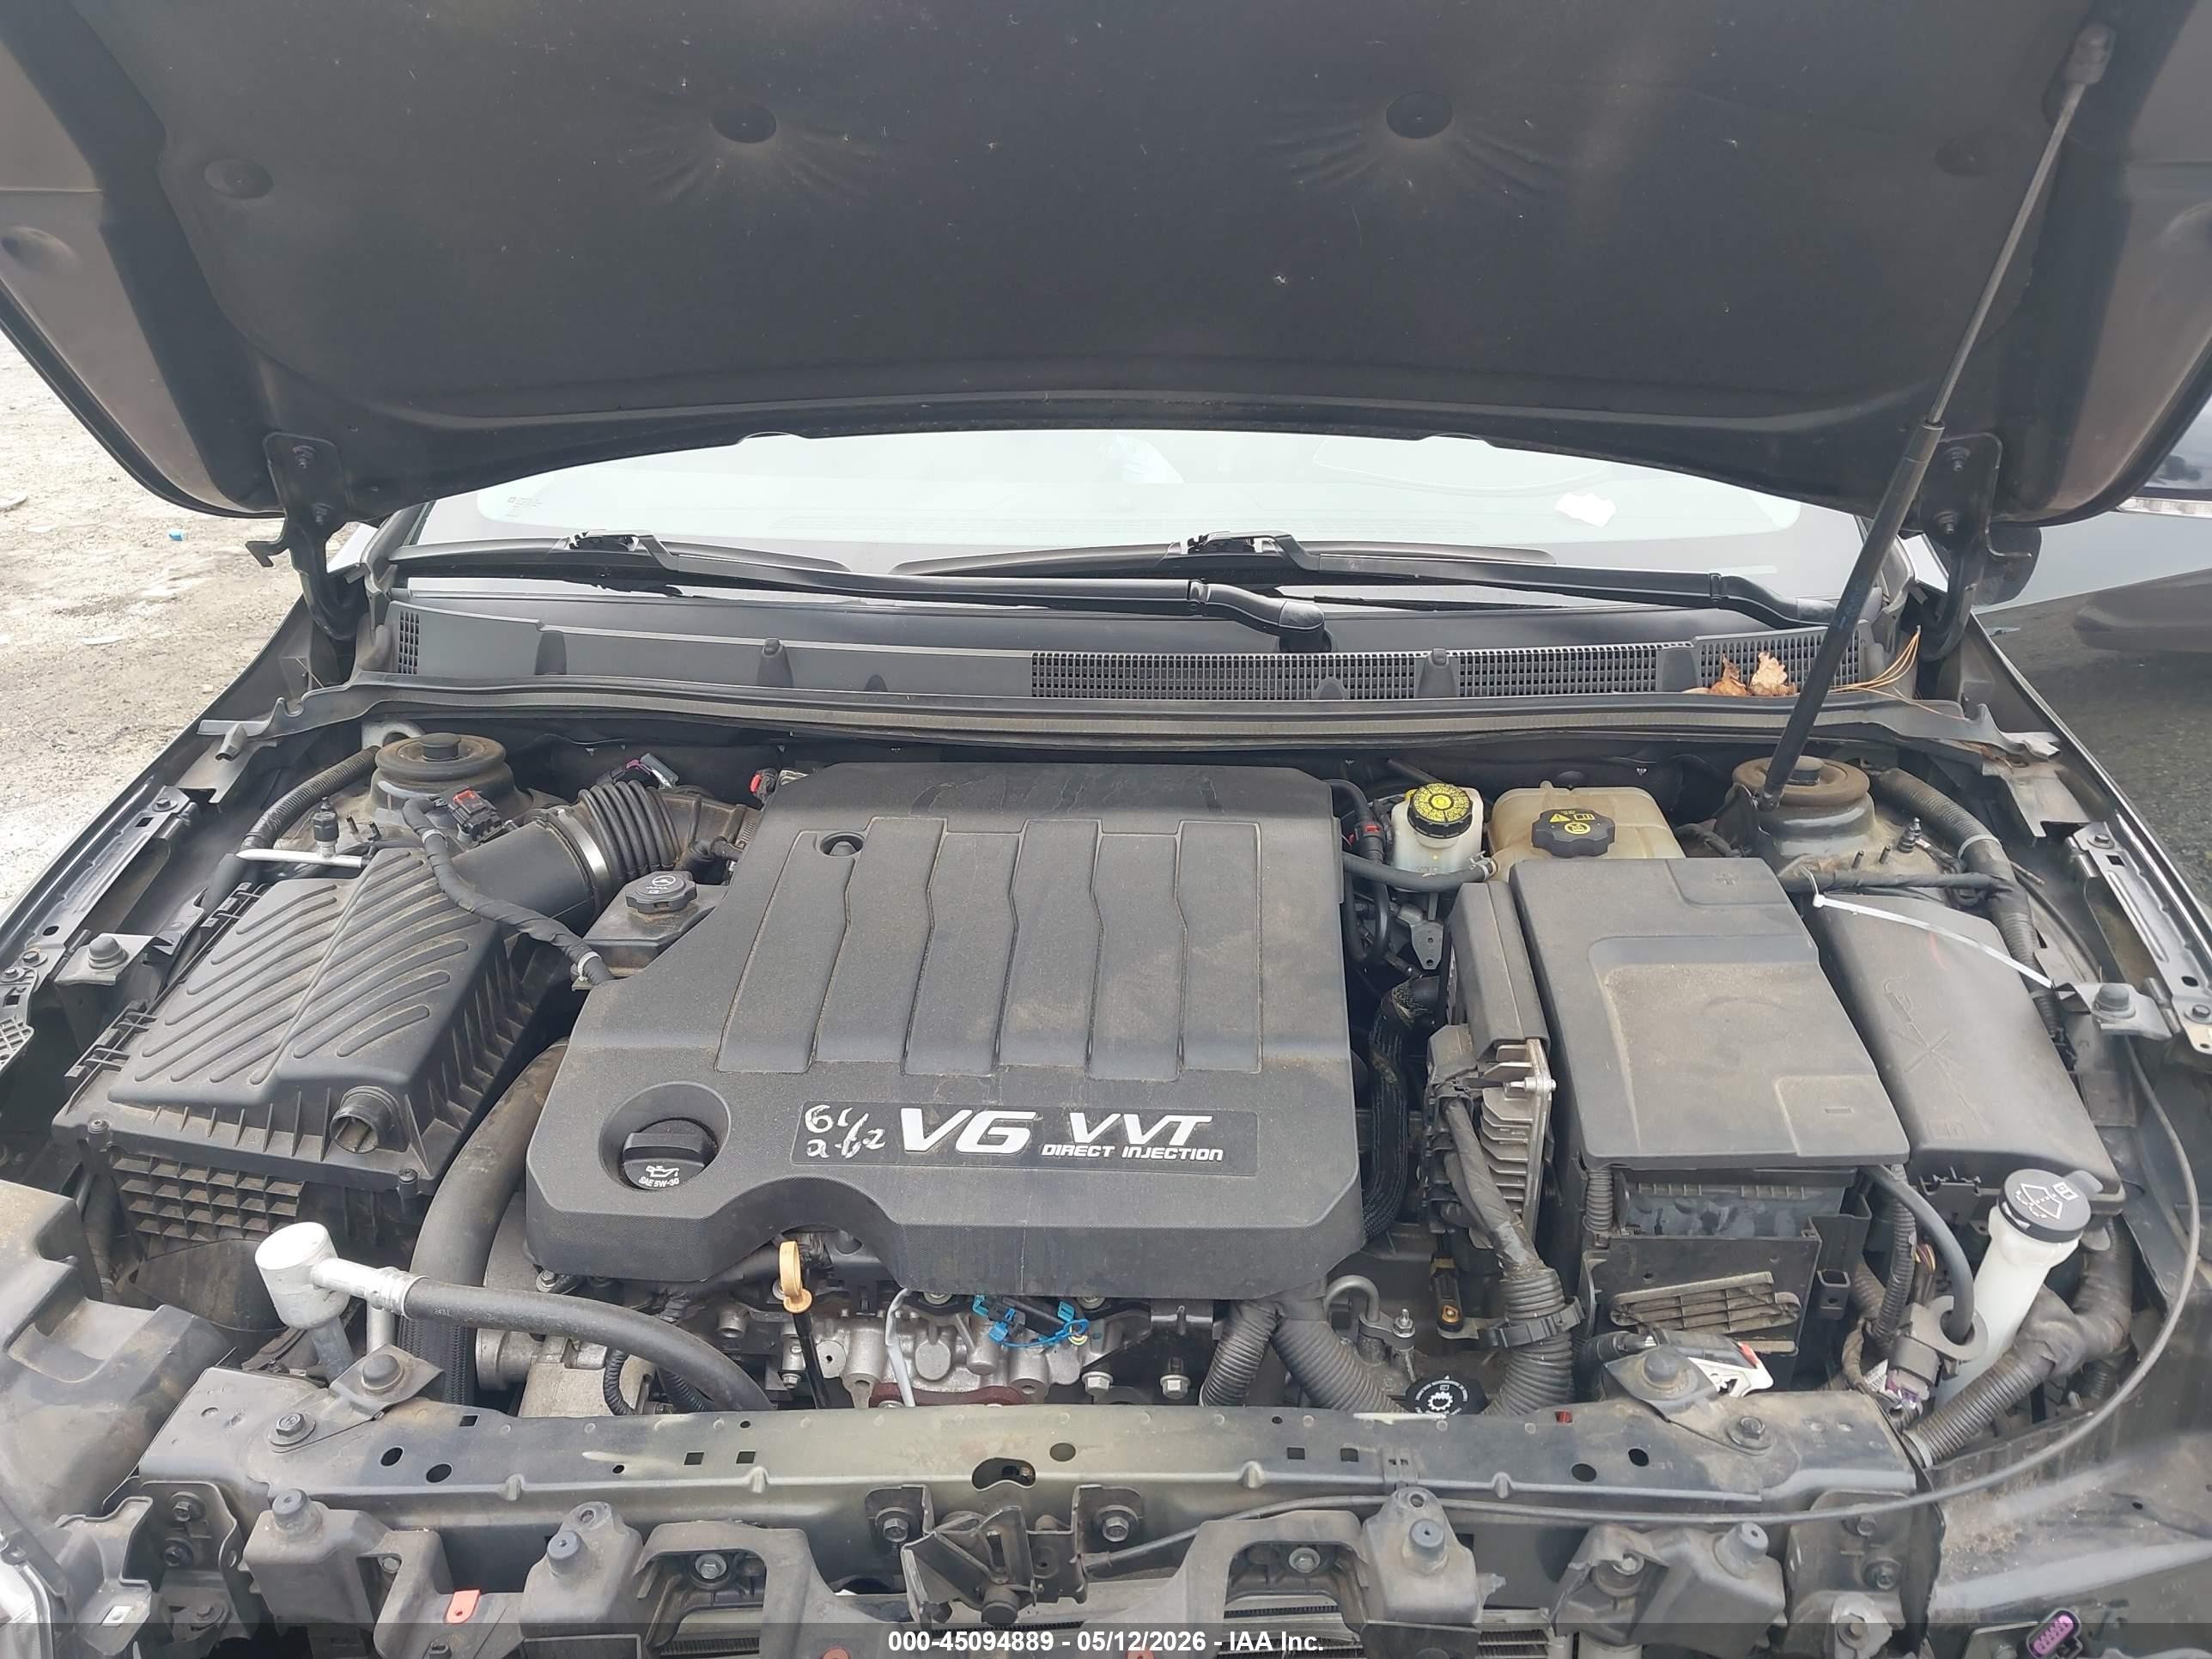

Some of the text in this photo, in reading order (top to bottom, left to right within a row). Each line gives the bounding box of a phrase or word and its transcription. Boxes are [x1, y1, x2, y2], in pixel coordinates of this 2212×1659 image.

[901, 1108, 1213, 1153] V6 VVT
[1041, 1144, 1224, 1162] DIRECT INJECTION
[638, 1176, 680, 1188] SAE 5W-30
